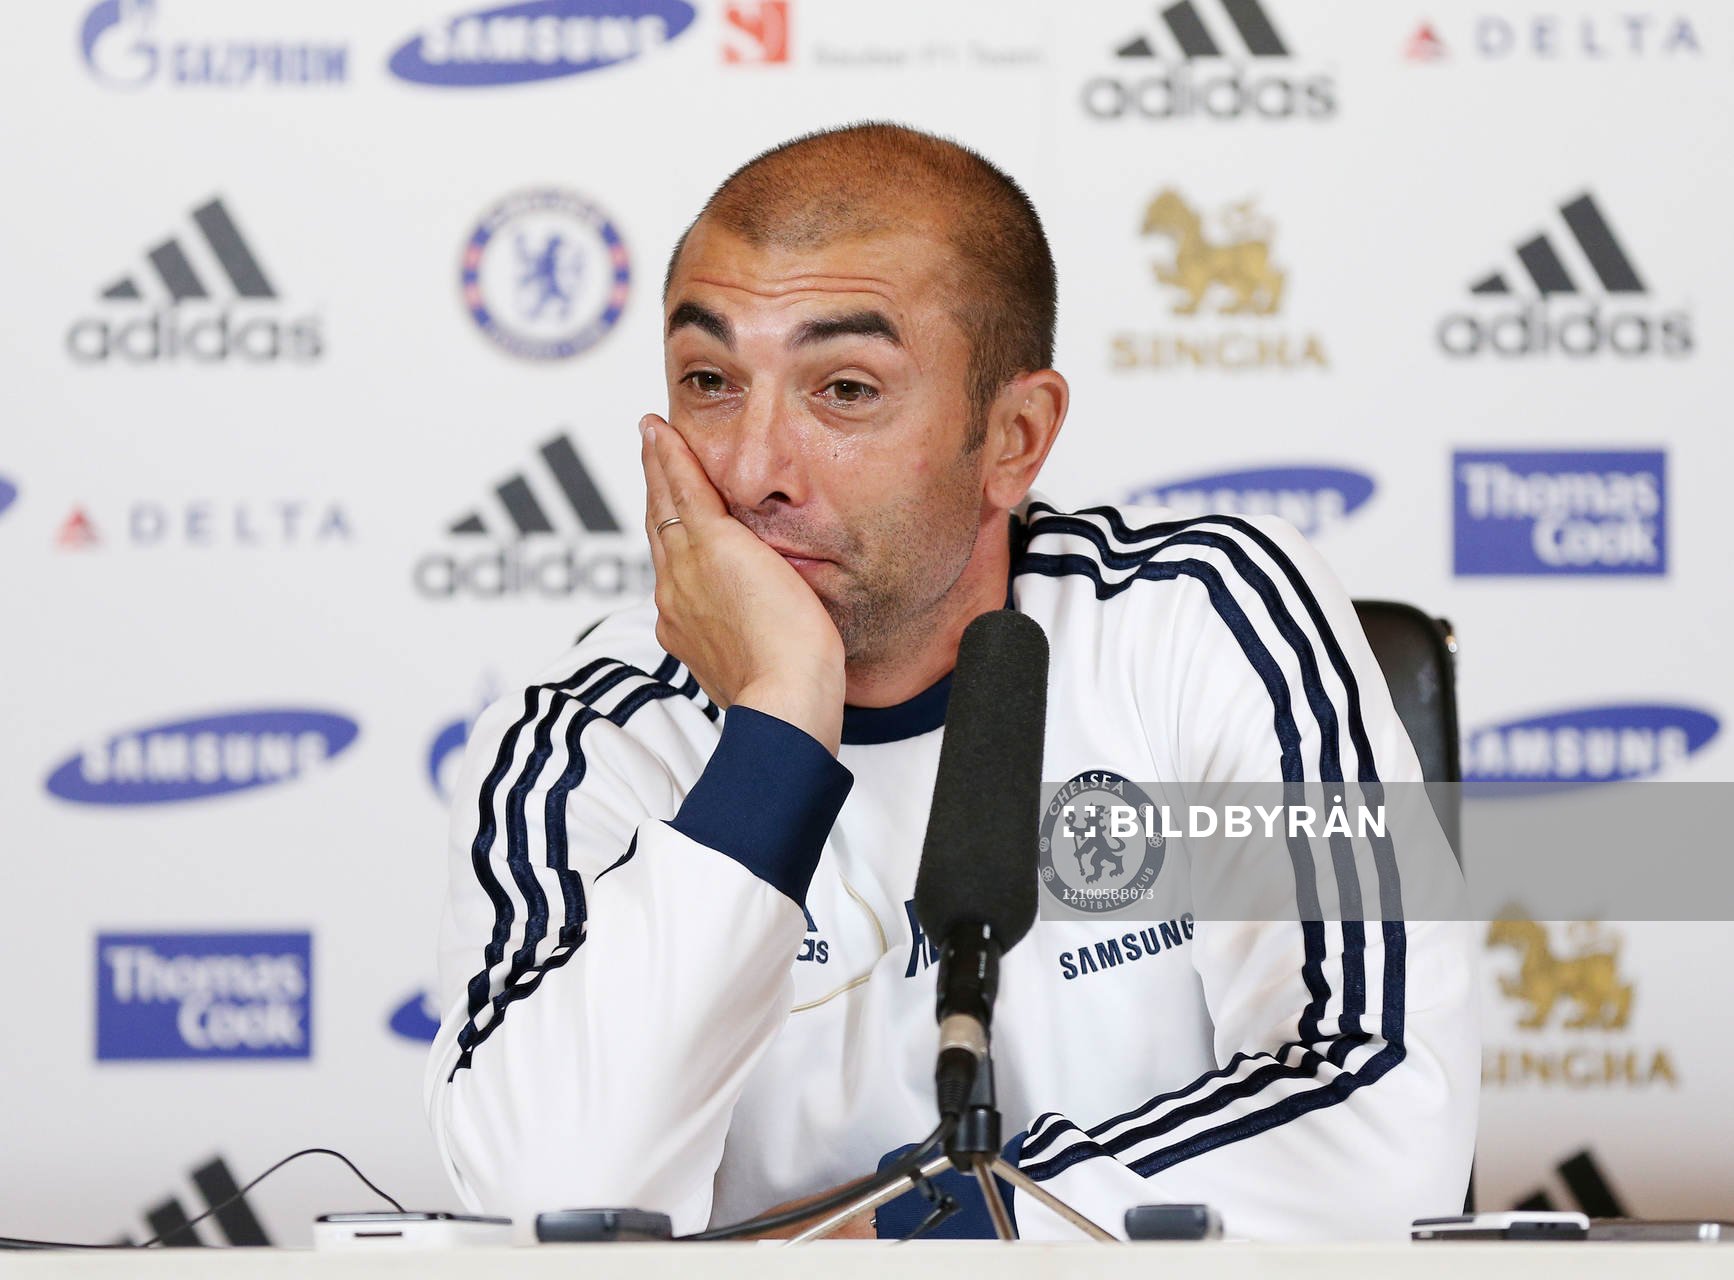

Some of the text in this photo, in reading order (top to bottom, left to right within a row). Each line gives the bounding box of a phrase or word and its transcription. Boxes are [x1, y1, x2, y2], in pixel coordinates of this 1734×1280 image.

[418, 15, 669, 64] SAMSUNG
[1476, 16, 1704, 58] DELTA
[1081, 66, 1338, 120] adidas
[66, 308, 326, 364] adidas
[1109, 332, 1328, 372] SINGHA
[1435, 304, 1696, 360] adidas
[1459, 460, 1662, 518] Thomas
[128, 501, 356, 545] DELTA
[1530, 516, 1660, 569] Cook
[80, 730, 330, 785] SAMSUNG
[1049, 773, 1125, 816] CHELSEA
[102, 942, 305, 1000] Thomas
[1058, 911, 1194, 981] SAMSUNG
[176, 999, 304, 1052] Cook
